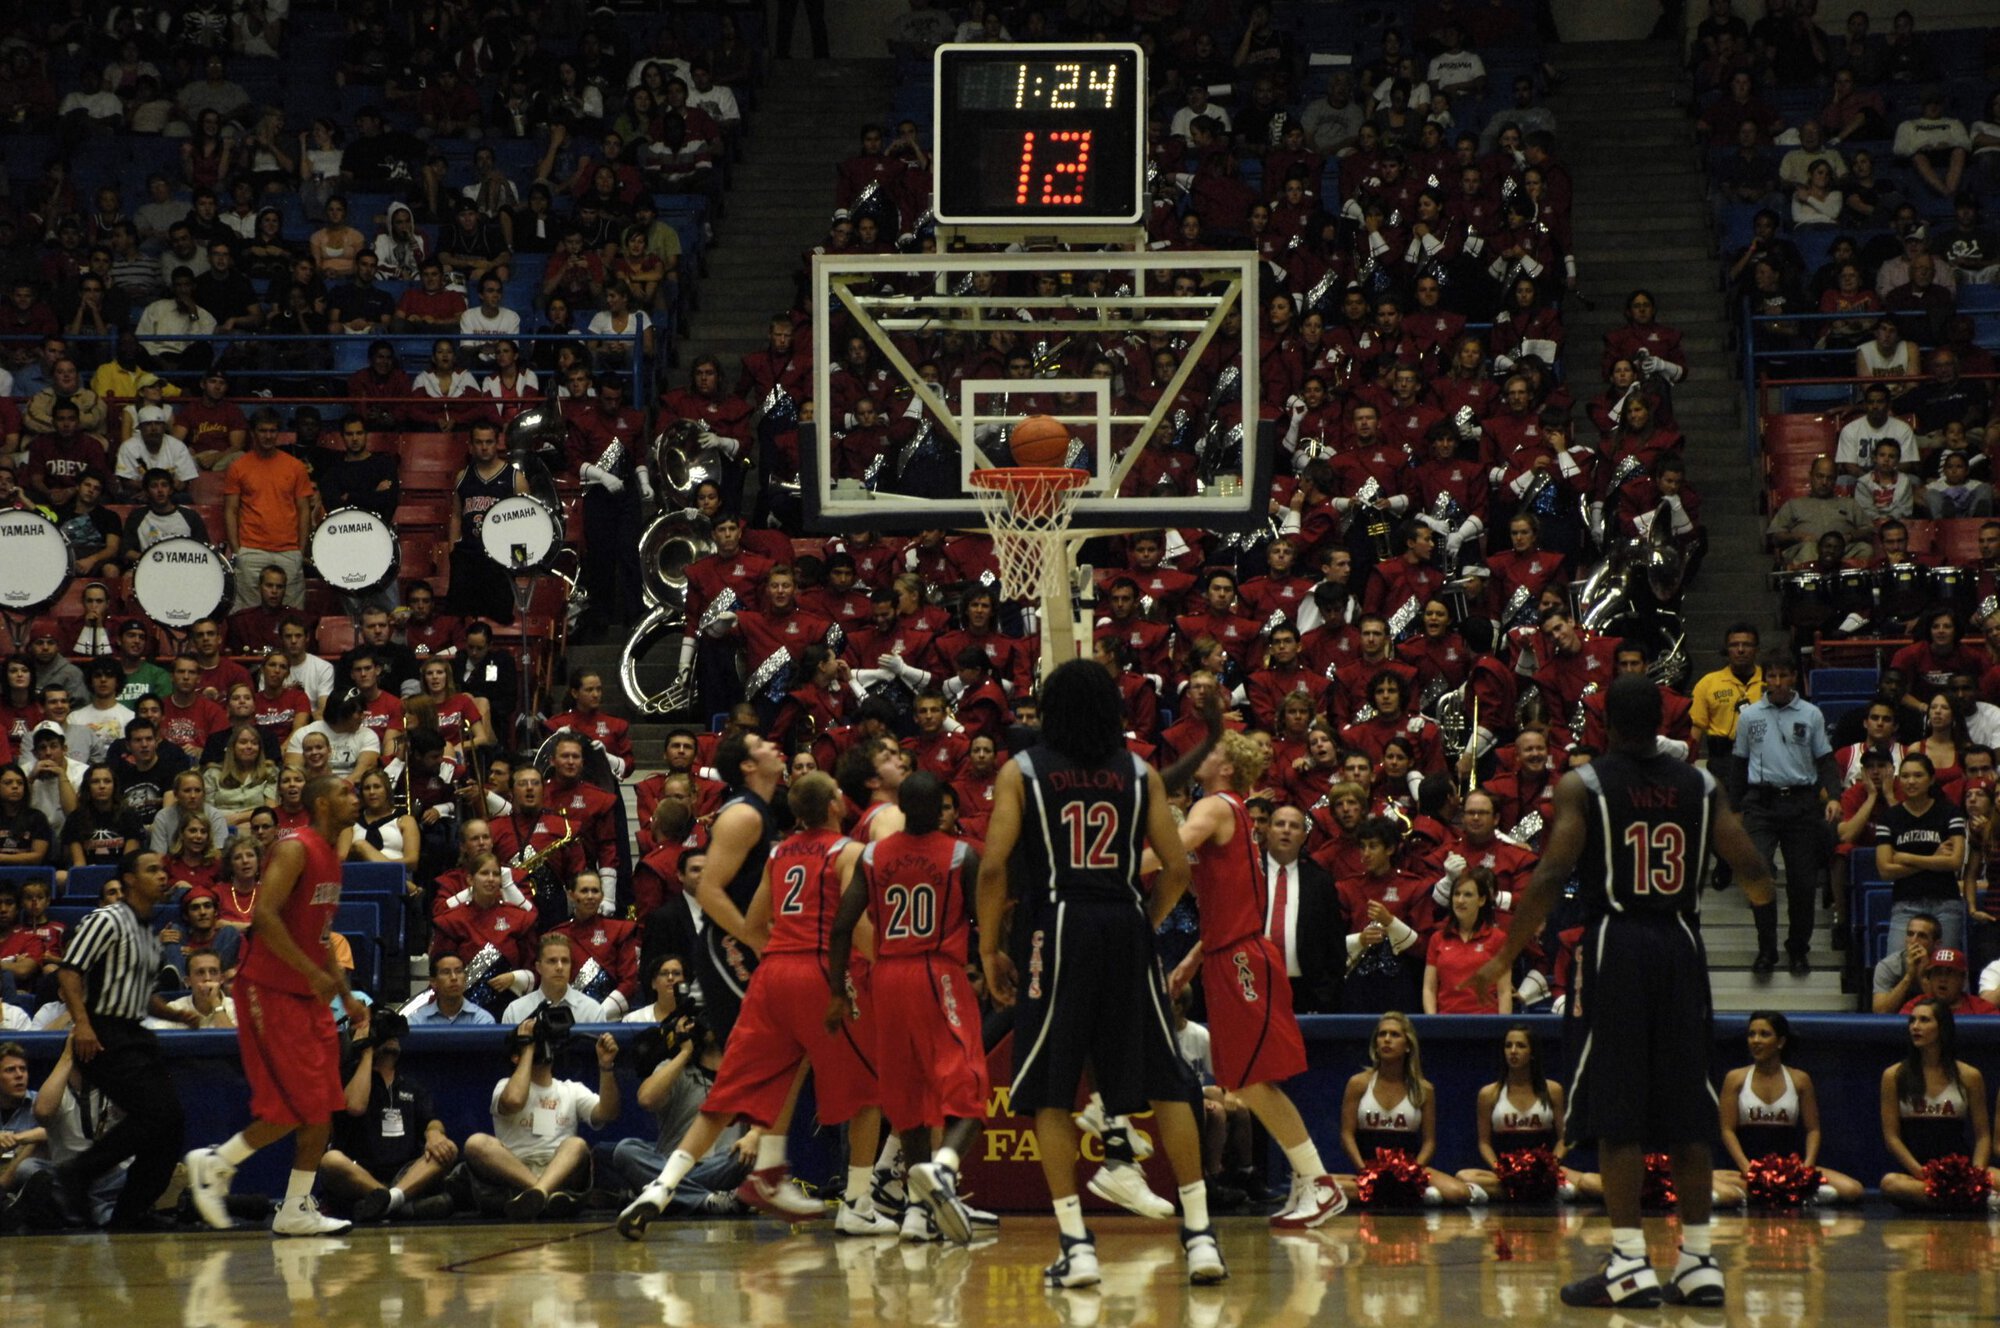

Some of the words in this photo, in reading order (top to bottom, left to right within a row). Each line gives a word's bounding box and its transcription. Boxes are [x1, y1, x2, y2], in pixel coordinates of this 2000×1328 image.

[1015, 63, 1117, 109] 1:24
[1016, 130, 1091, 205] 12
[1, 524, 45, 536] YAMAHA
[338, 522, 373, 533] YAMAHA
[501, 506, 537, 523] YAMAHA
[166, 552, 208, 564] YAMAHA
[1047, 766, 1125, 793] DILLON
[1627, 784, 1680, 809] WISE
[1060, 801, 1119, 870] 12
[1896, 829, 1942, 845] ARIZONA
[1624, 820, 1686, 895] 13
[780, 864, 807, 916] 2
[884, 882, 936, 940] 20
[1233, 952, 1258, 1002] CATS
[983, 1129, 1154, 1162] FAG
